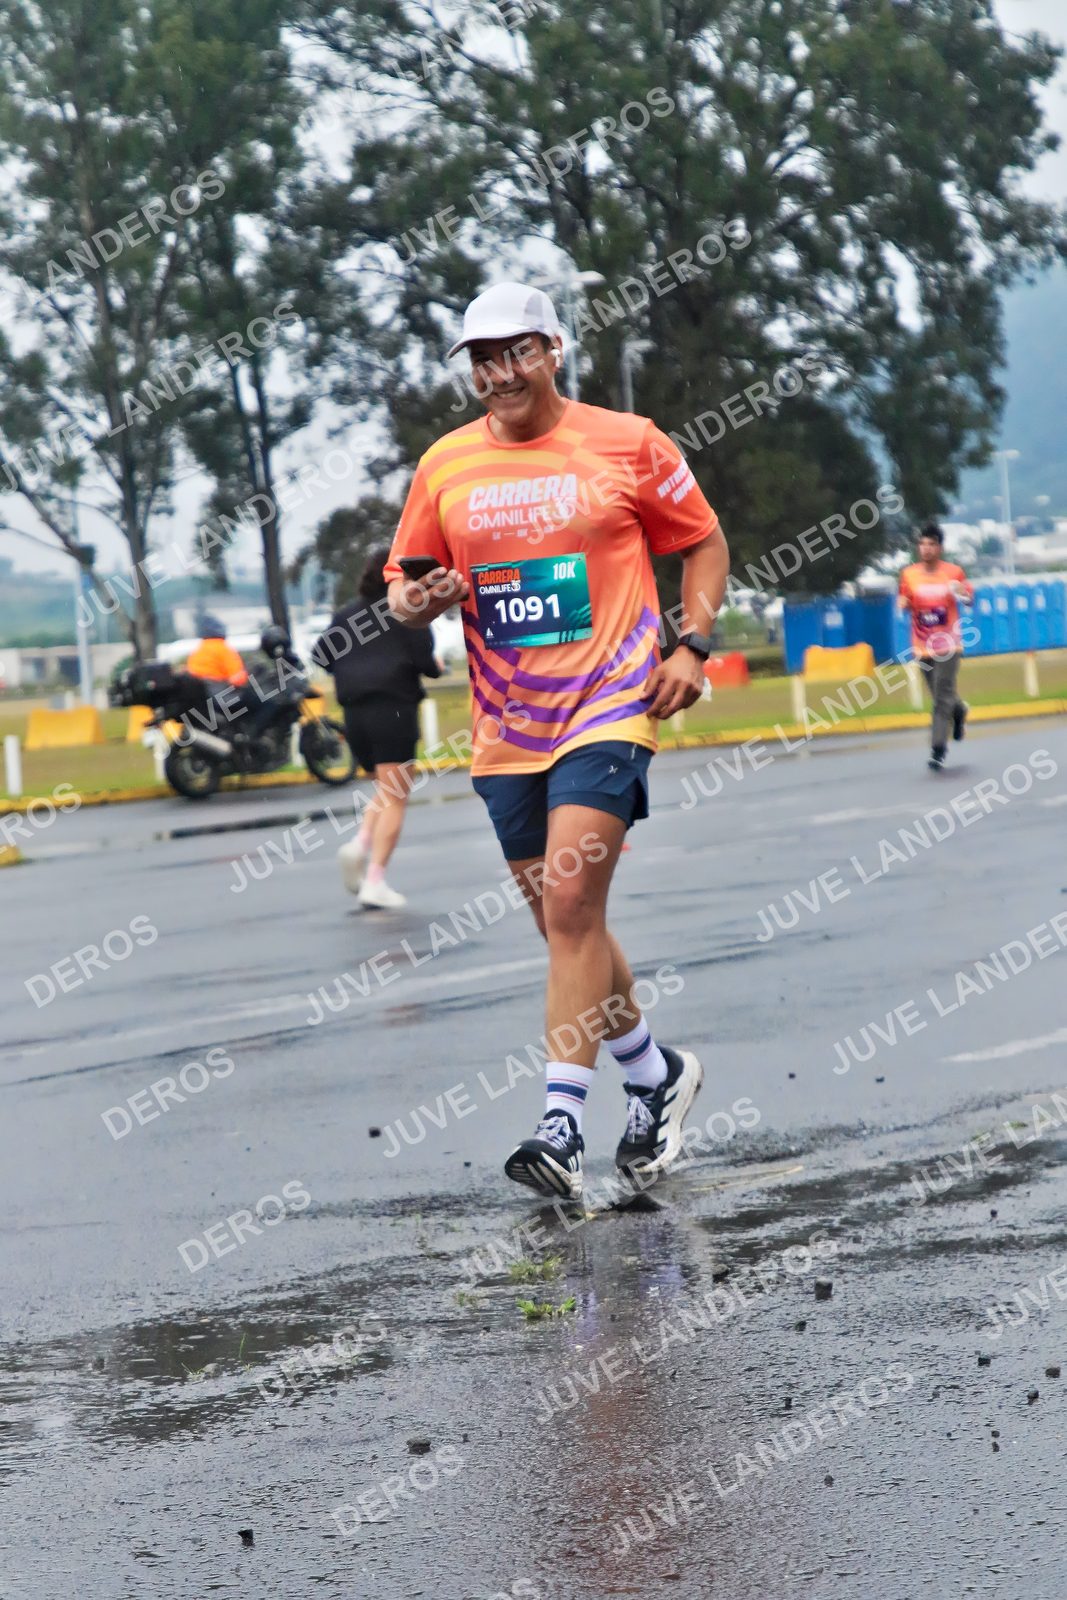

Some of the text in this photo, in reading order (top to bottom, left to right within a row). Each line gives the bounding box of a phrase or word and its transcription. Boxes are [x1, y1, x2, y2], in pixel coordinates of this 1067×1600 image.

[468, 473, 577, 512] CARRERA
[468, 504, 551, 532] OMNILIFE
[478, 568, 521, 586] CARRERA
[553, 561, 577, 580] 10K
[479, 583, 511, 595] OMNILIFE
[494, 594, 561, 624] 1091
